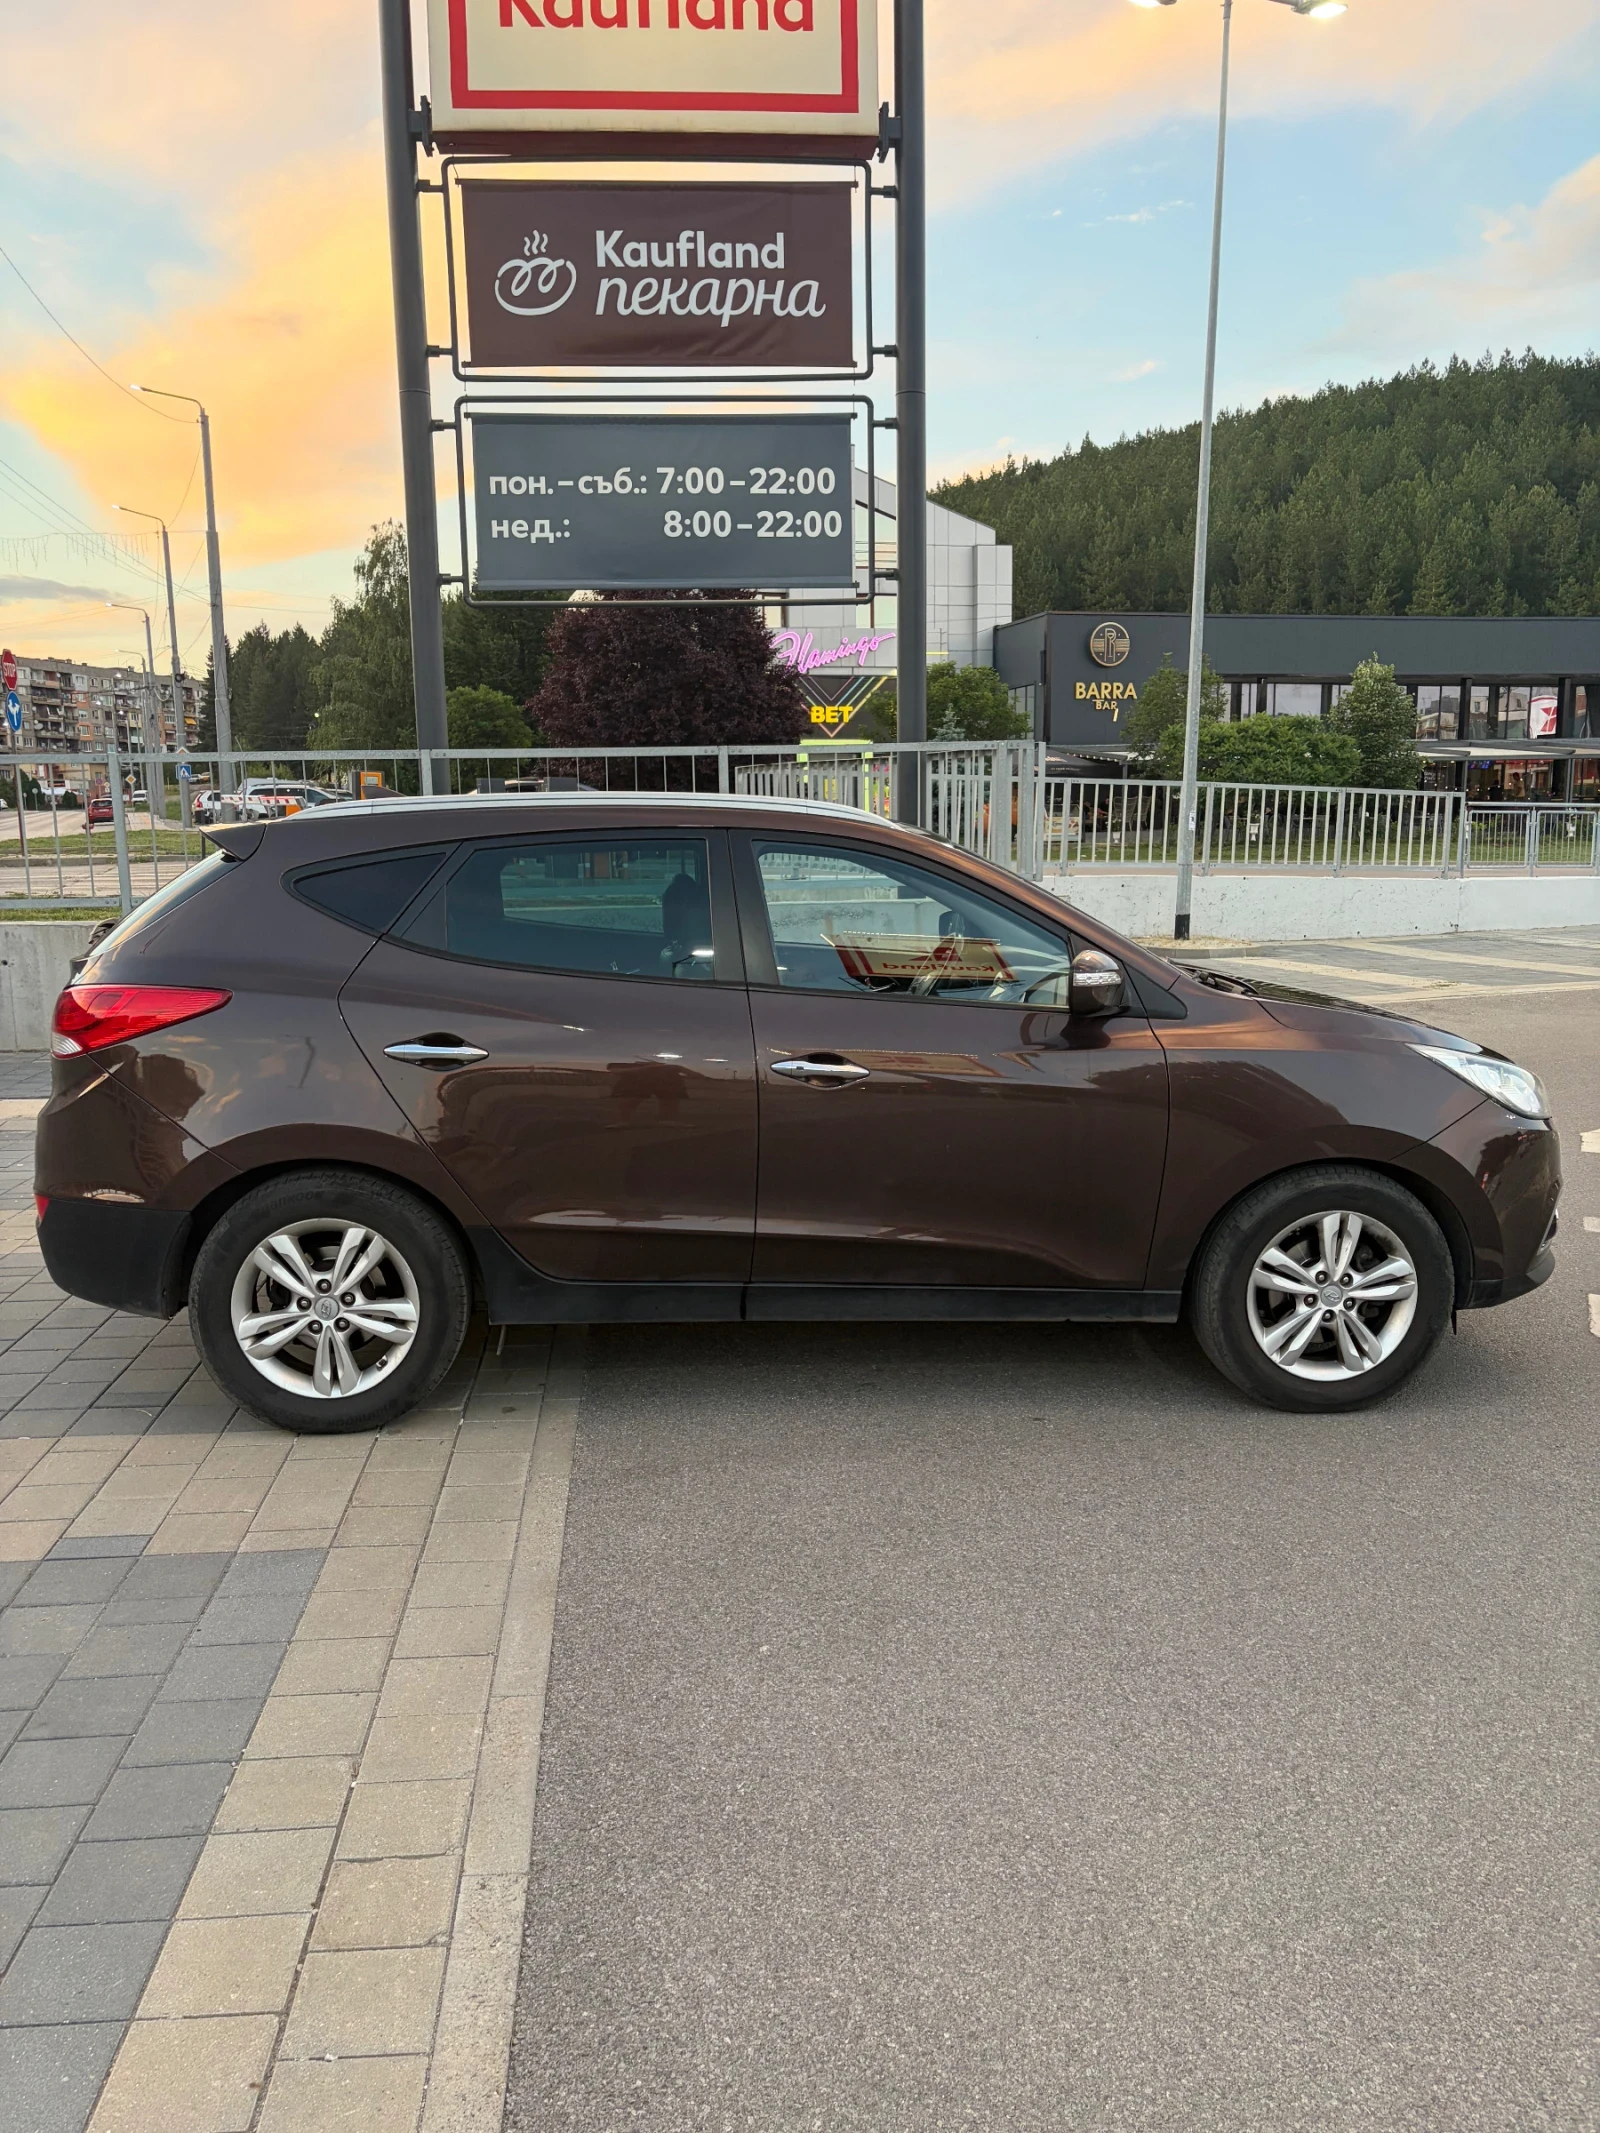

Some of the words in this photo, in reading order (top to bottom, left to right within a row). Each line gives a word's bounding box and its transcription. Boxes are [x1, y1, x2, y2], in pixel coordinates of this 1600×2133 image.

[596, 230, 785, 269] Kaufland
[595, 277, 827, 328] пекарна
[491, 518, 571, 544] нед.:
[769, 631, 897, 675] Flamingo
[3, 662, 16, 678] STOP
[1075, 682, 1138, 700] BARRA
[810, 706, 853, 723] BET
[1095, 701, 1118, 710] BAR
